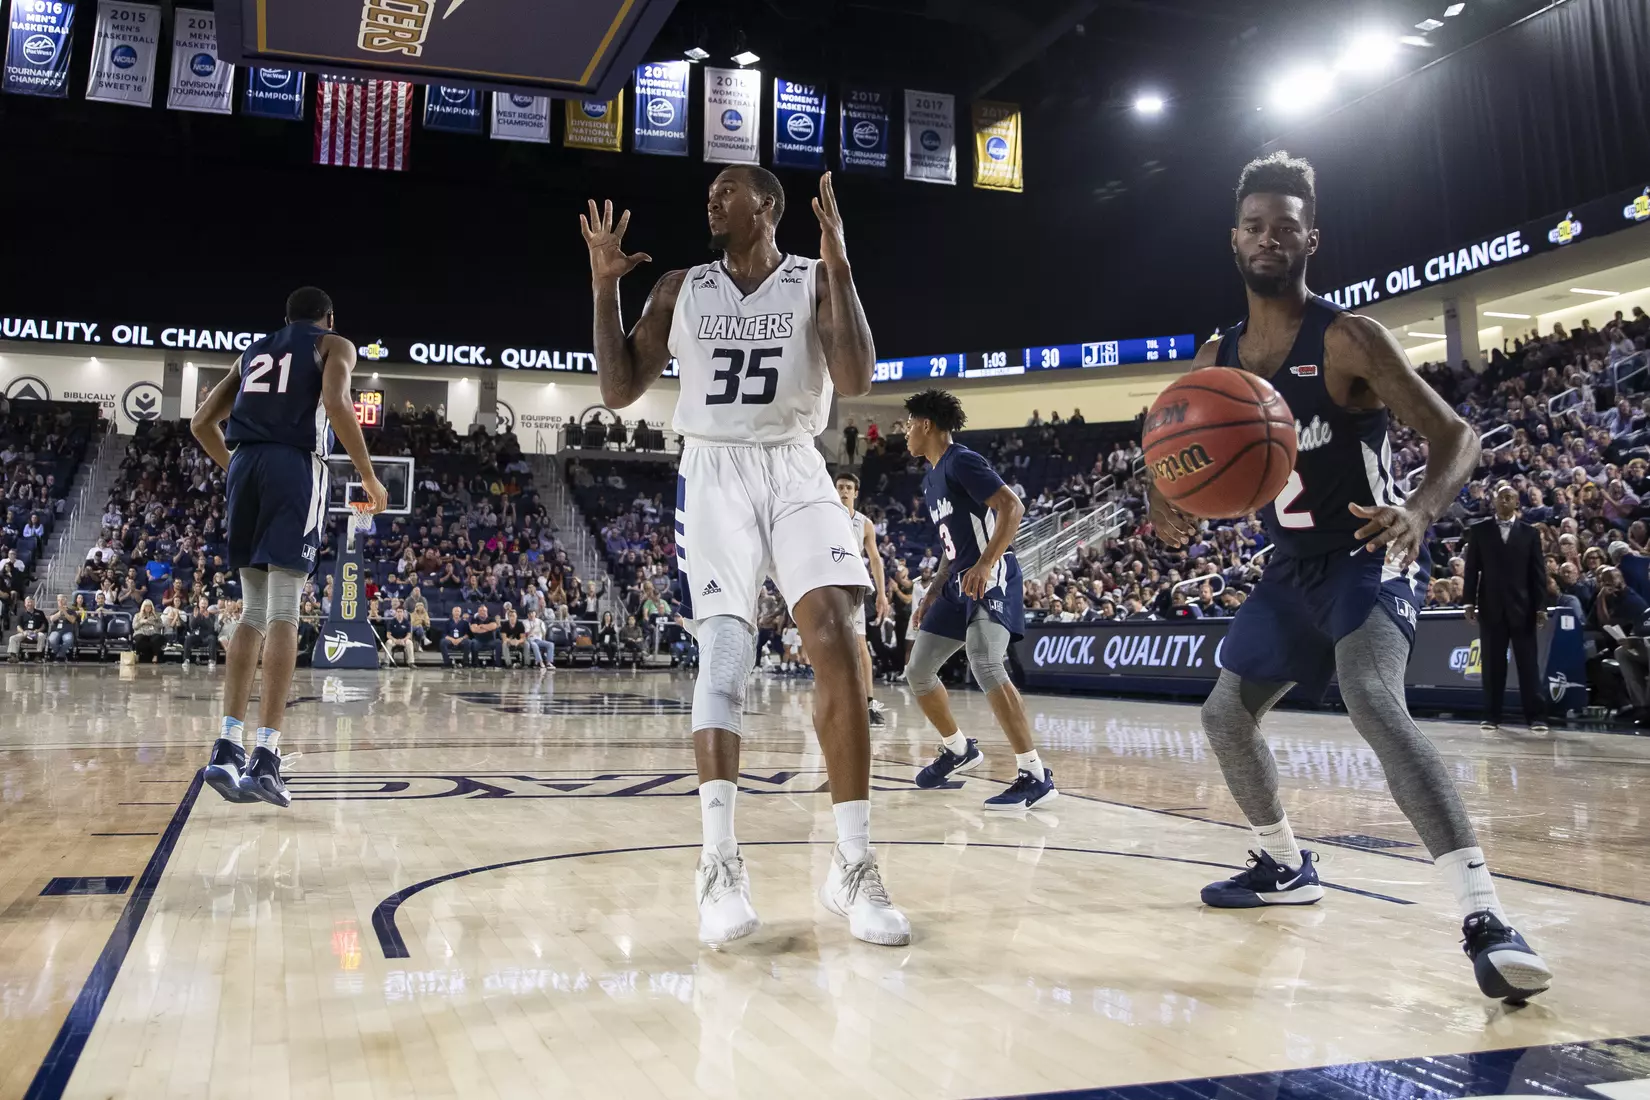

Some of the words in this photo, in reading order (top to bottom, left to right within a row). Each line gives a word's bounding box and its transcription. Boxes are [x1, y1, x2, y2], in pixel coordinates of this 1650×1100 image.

[25, 1, 63, 14] 2016
[26, 14, 57, 24] MEN'S
[110, 9, 146, 23] 2015
[111, 23, 141, 33] MEN'S
[188, 18, 214, 30] 201
[98, 32, 155, 44] BASKETBALL
[176, 40, 217, 51] BASKETB
[113, 54, 136, 64] NCAA
[7, 66, 66, 79] TOURNAMENT
[97, 71, 139, 82] DIVISION
[262, 72, 287, 80] PacWest
[10, 75, 62, 87] CHAMPIONS
[99, 81, 130, 91] SWEET
[133, 84, 143, 93] 16
[180, 80, 217, 90] DIVISION
[639, 78, 680, 89] WOMEN'S
[172, 87, 229, 99] TOURNAMENT
[635, 86, 686, 98] BASKETBALL
[712, 89, 750, 98] WOMEN'S
[785, 81, 816, 95] 2017
[246, 89, 301, 102] CHAMPIONS
[512, 94, 533, 103] NCAA
[780, 93, 820, 105] WOMEN'S
[851, 90, 880, 103] 2017
[584, 101, 606, 112] NCAA
[916, 98, 944, 110] 2017
[427, 104, 480, 117] CHAMPIONS
[496, 109, 517, 119] WEST
[517, 112, 547, 122] REGION
[497, 118, 545, 129] CHAMPIONS
[571, 119, 609, 129] DIVISION
[571, 127, 615, 138] NATIONAL
[635, 128, 685, 139] CHAMPIONS
[713, 134, 746, 143] DIVISION
[569, 134, 604, 144] RUNNER
[707, 141, 757, 151] TOURNAMENT
[776, 142, 824, 153] CHAMPIONS
[845, 157, 887, 167] CHAMPIONS
[1385, 265, 1422, 294] OIL
[1424, 230, 1530, 282] CHANGE.
[0, 318, 101, 342] UALITY.
[112, 325, 154, 346] OIL
[697, 312, 793, 341] LANCERS
[409, 342, 492, 366] QUICK.
[981, 351, 1007, 369] 1:03
[1040, 347, 1060, 369] 30
[243, 352, 293, 393] 21
[929, 356, 948, 378] 29
[705, 347, 783, 405] 35
[63, 391, 117, 401] BIBLICALLY
[360, 392, 382, 405] 1:03
[521, 414, 562, 423] EQUIPPED
[624, 419, 665, 428] GLOALLY
[521, 421, 532, 429] TO
[534, 422, 561, 430] SERVE
[1294, 414, 1332, 452] tate
[1274, 469, 1316, 529] 2
[939, 523, 956, 560] 3
[341, 562, 358, 620] CBU
[701, 588, 722, 597] adidas
[1033, 635, 1096, 667] QUICK.
[1103, 635, 1206, 669] QUALITY.
